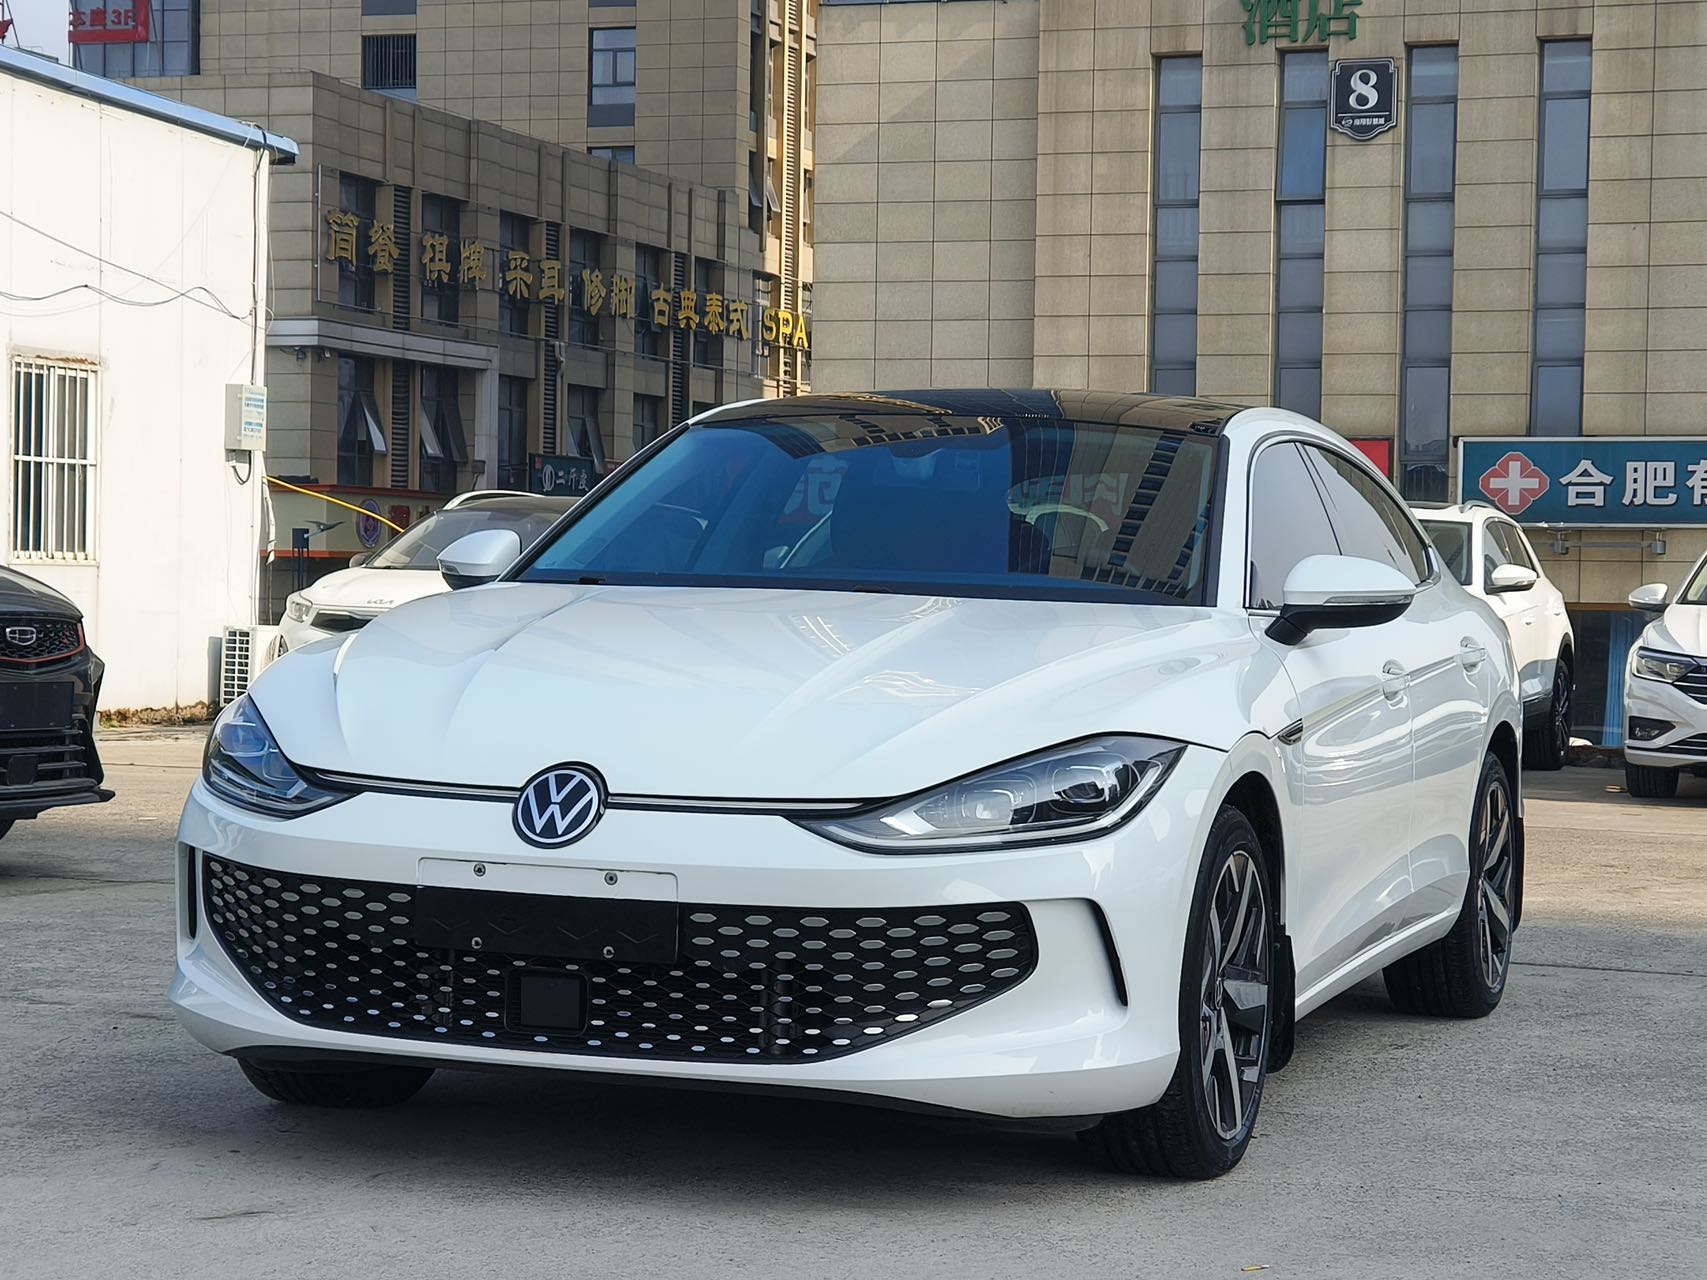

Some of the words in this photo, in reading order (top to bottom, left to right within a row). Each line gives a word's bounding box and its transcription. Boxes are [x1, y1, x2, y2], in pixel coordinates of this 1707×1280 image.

[1241, 0, 1363, 46] 酒店
[1349, 69, 1379, 110] 8
[421, 232, 487, 290] 棋牌
[505, 250, 565, 305] 采耳
[651, 282, 749, 340] 古典泰式
[763, 307, 809, 349] SPA
